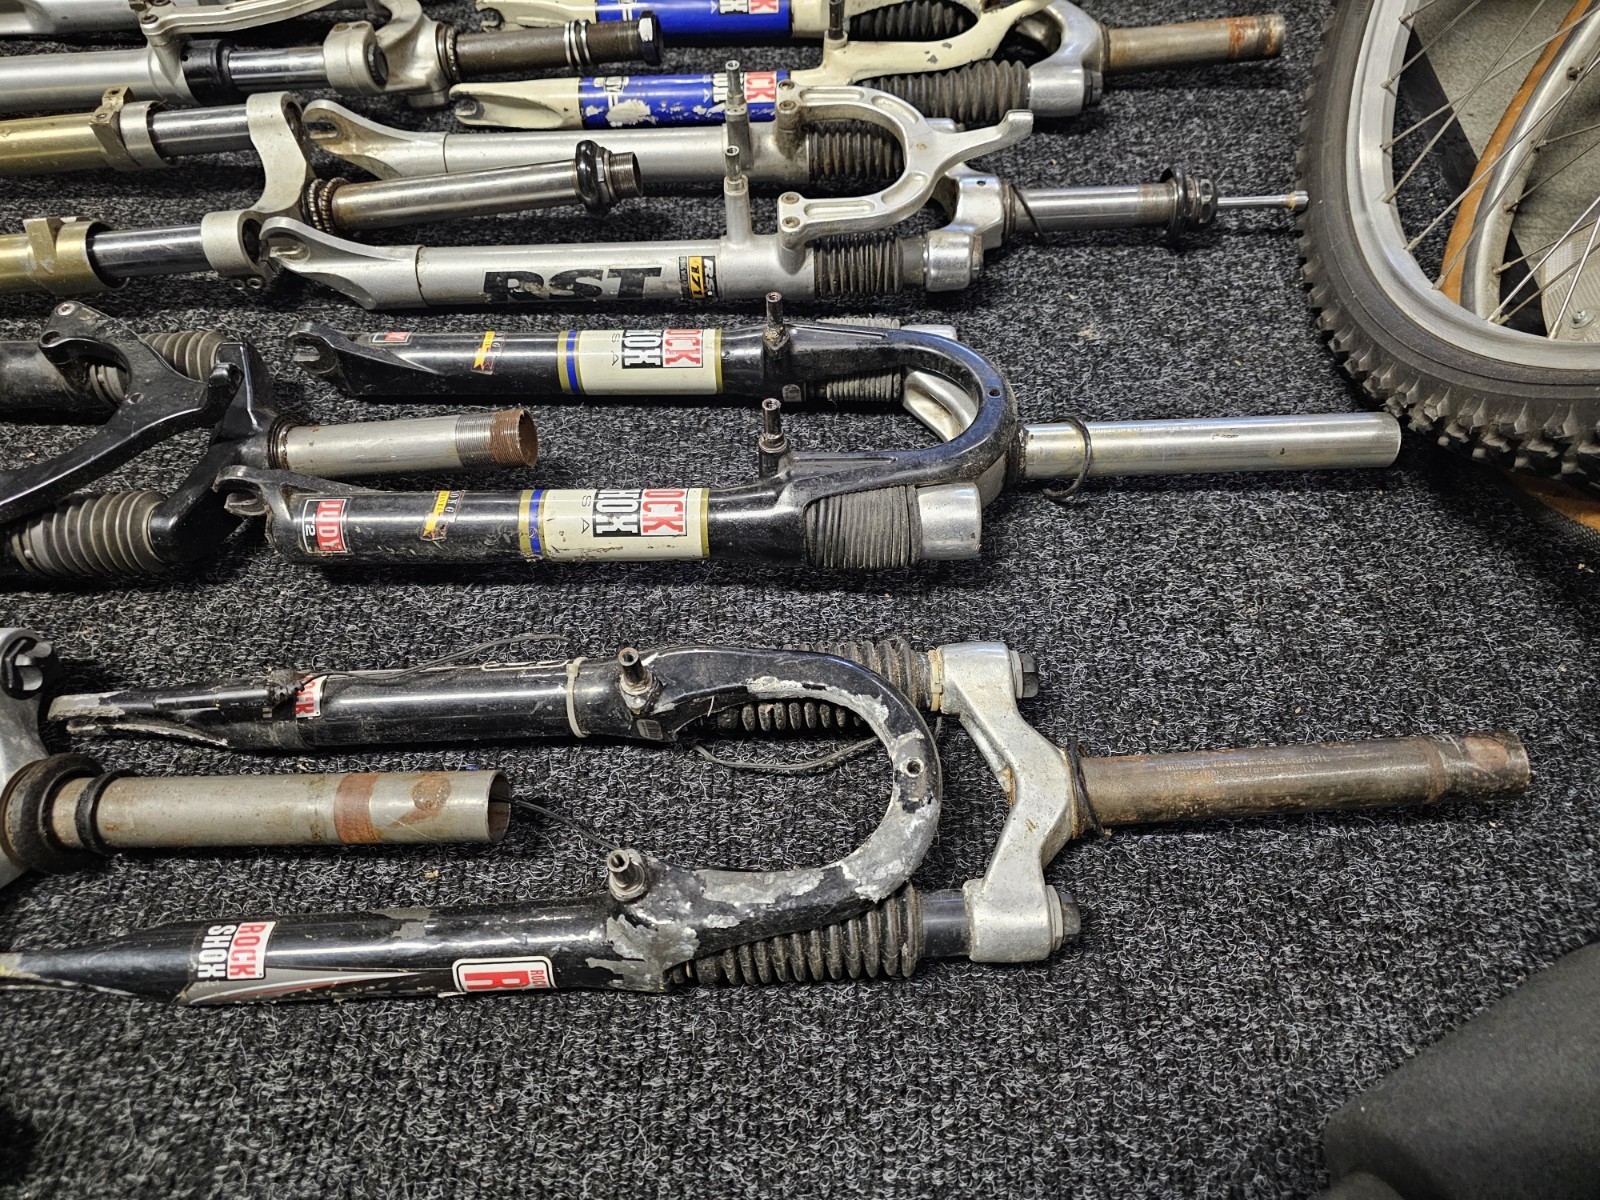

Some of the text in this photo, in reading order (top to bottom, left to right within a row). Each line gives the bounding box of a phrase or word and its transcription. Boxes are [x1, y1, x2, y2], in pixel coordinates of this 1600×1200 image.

[483, 266, 663, 300] RST
[623, 329, 661, 367] HOX
[664, 329, 701, 365] OCK
[305, 513, 316, 537] T2
[318, 501, 341, 550] JUDY
[595, 489, 640, 534] HOX
[642, 489, 686, 534] OCK
[197, 924, 237, 978] SHOX
[229, 923, 267, 977] ROCK
